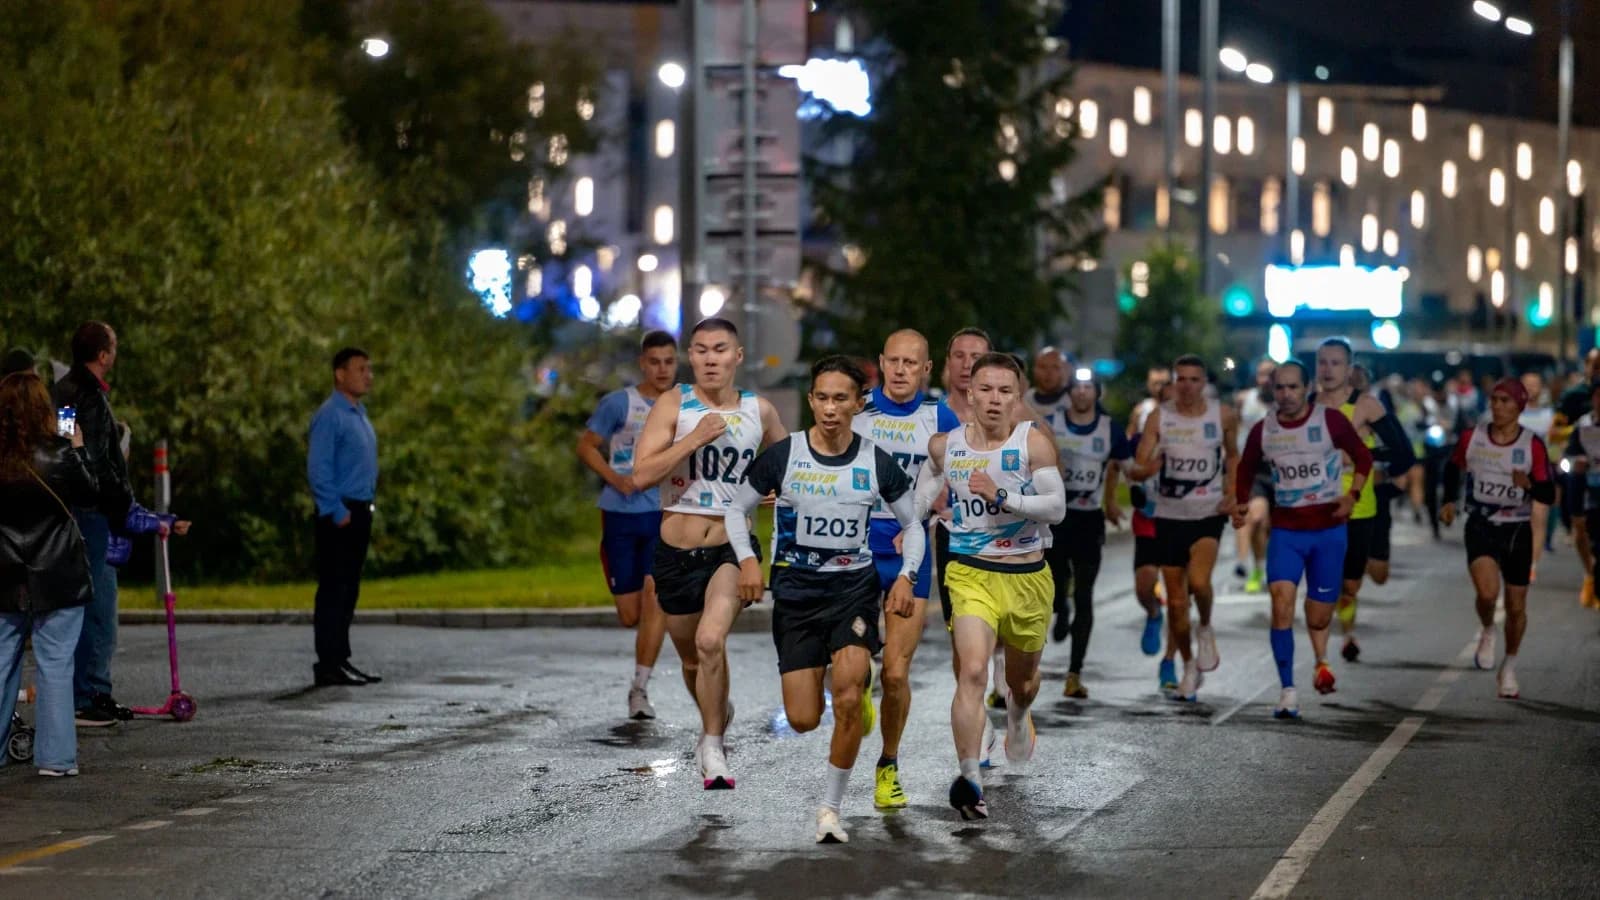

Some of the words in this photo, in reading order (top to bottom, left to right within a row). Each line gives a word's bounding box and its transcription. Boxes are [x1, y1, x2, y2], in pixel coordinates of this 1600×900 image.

[872, 429, 916, 444] ЯМАЛ
[688, 445, 756, 484] 1022
[1169, 456, 1208, 473] 1270
[1280, 463, 1321, 480] 1086
[790, 482, 837, 497] ЯМАЛ
[1479, 481, 1518, 499] 1276
[962, 498, 1013, 518] 106
[804, 515, 859, 538] 1203
